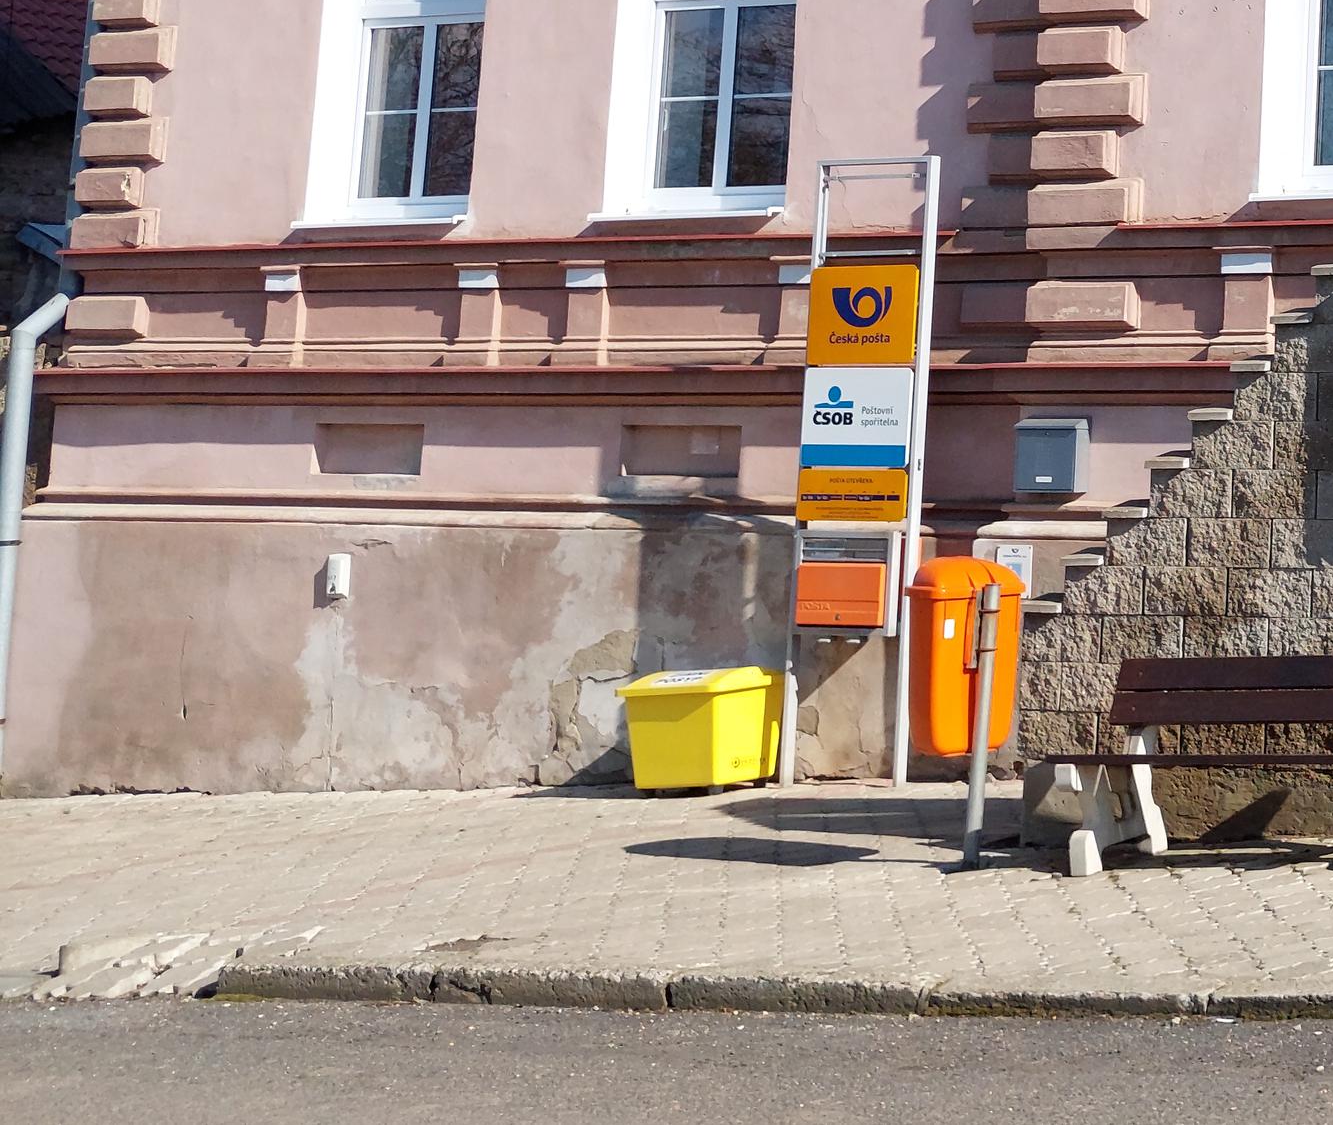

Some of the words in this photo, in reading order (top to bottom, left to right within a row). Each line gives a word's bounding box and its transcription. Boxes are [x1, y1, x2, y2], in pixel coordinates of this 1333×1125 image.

[829, 332, 859, 344] Česká
[861, 333, 890, 345] pošta
[861, 406, 894, 415] Poštovní
[812, 410, 854, 425] ČSOB
[860, 419, 899, 428] spořitelna
